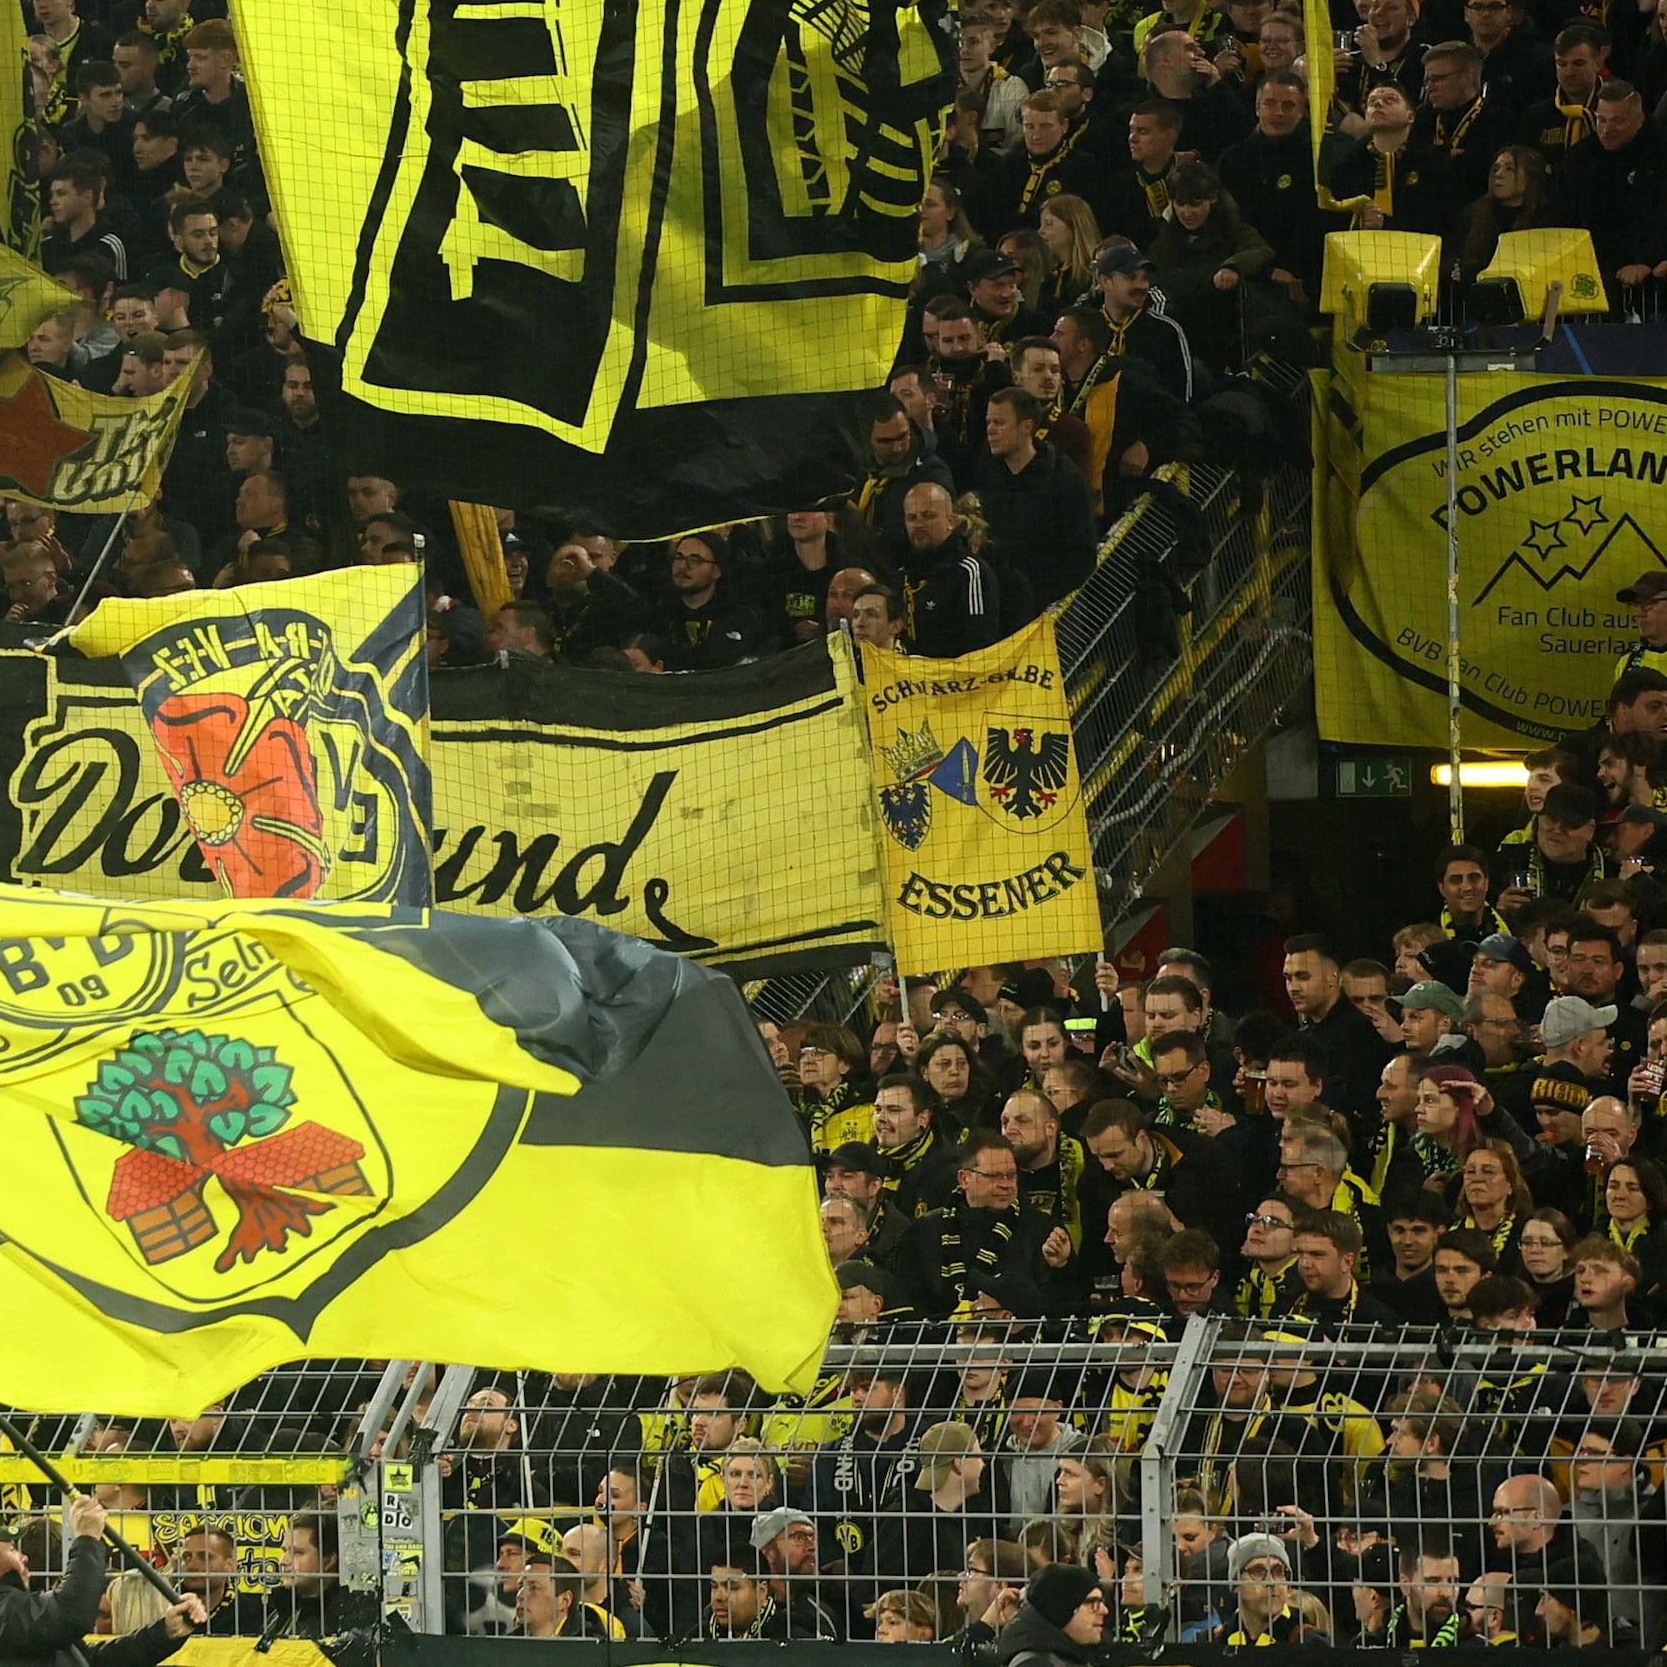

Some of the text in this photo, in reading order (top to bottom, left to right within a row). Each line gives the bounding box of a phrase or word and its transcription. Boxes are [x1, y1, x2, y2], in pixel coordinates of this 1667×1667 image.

[1478, 413, 1549, 459] stehen
[1556, 408, 1591, 427] mit
[1497, 605, 1537, 627] Fan
[1546, 605, 1596, 628] Club
[1395, 626, 1444, 662] BVB
[1483, 672, 1528, 705] Club
[896, 850, 1087, 921] ESSENER
[57, 974, 110, 1006] 09
